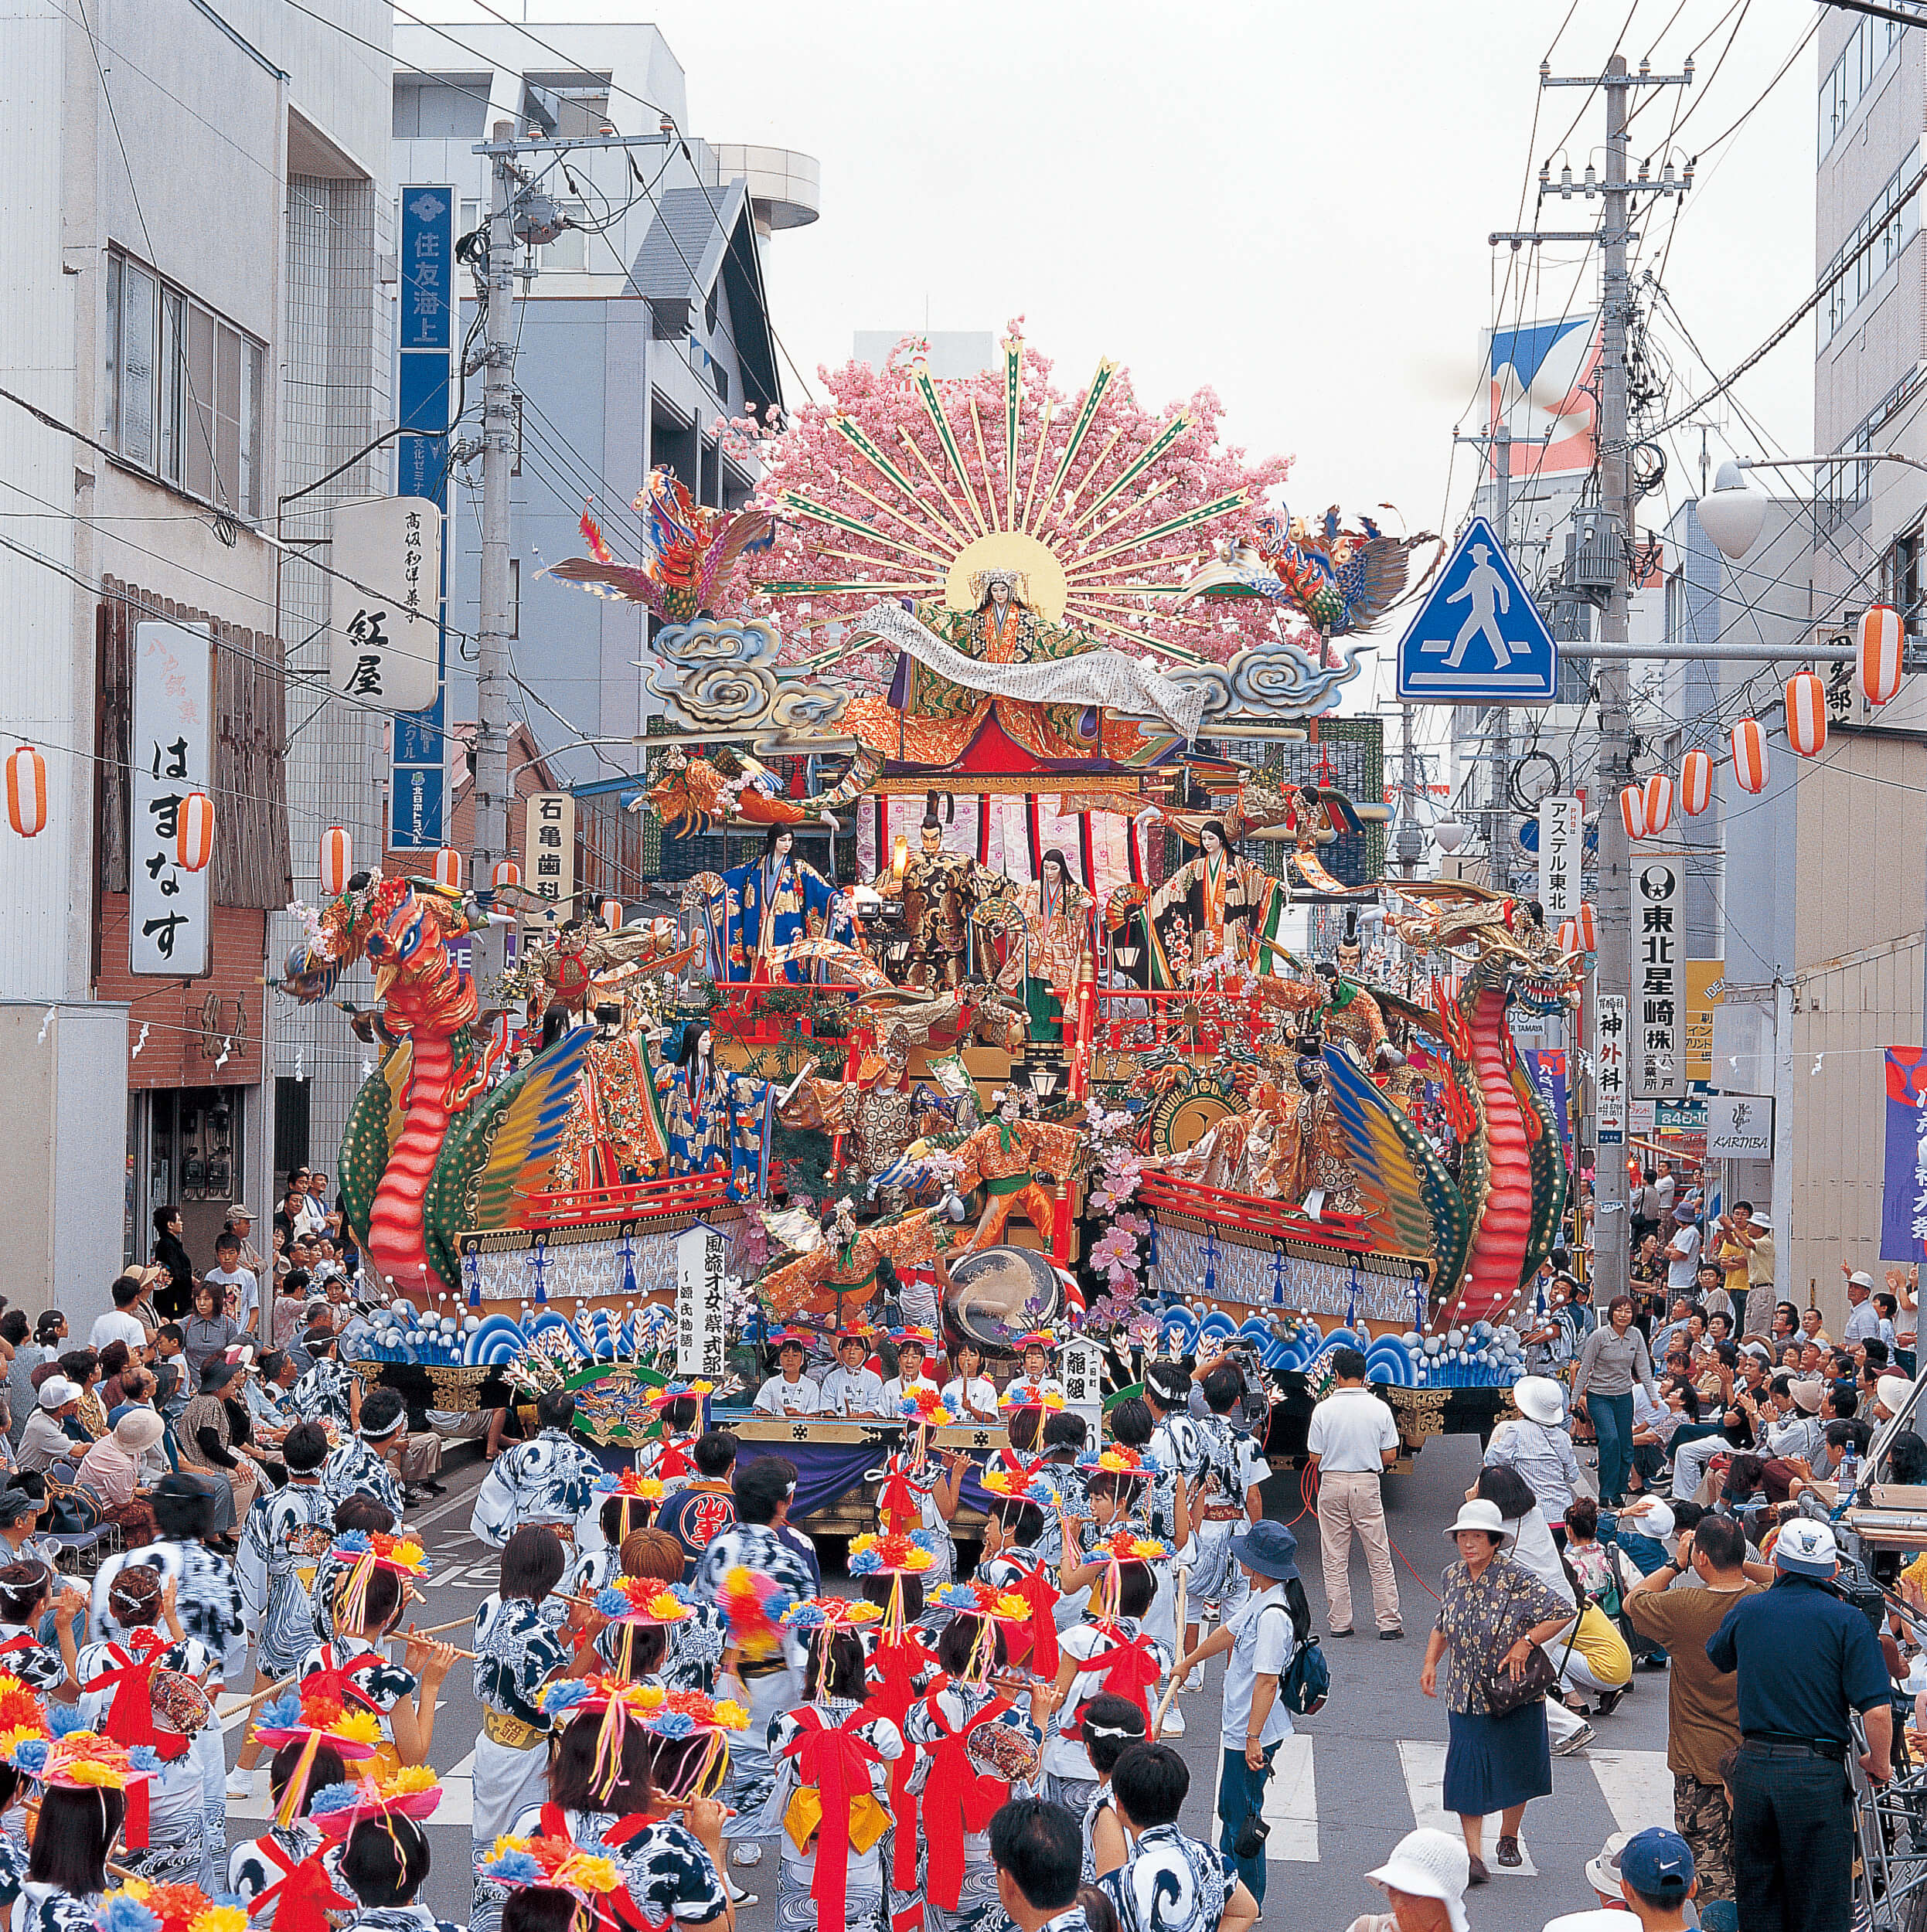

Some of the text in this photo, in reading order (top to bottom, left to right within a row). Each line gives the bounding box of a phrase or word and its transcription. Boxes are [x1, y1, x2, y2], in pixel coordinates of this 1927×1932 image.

[413, 232, 439, 342] 住友海上
[414, 438, 424, 496] 文化ゼミナ
[344, 609, 389, 696] 紅屋
[142, 735, 189, 961] はまなす
[412, 786, 424, 844] 北日本トラベル
[537, 797, 563, 902] 石亀歯科
[1548, 802, 1568, 911] アステル東北
[1687, 1026, 1712, 1036] イン
[1643, 1054, 1657, 1091] 営業所
[1088, 1347, 1098, 1388] 十一日町
